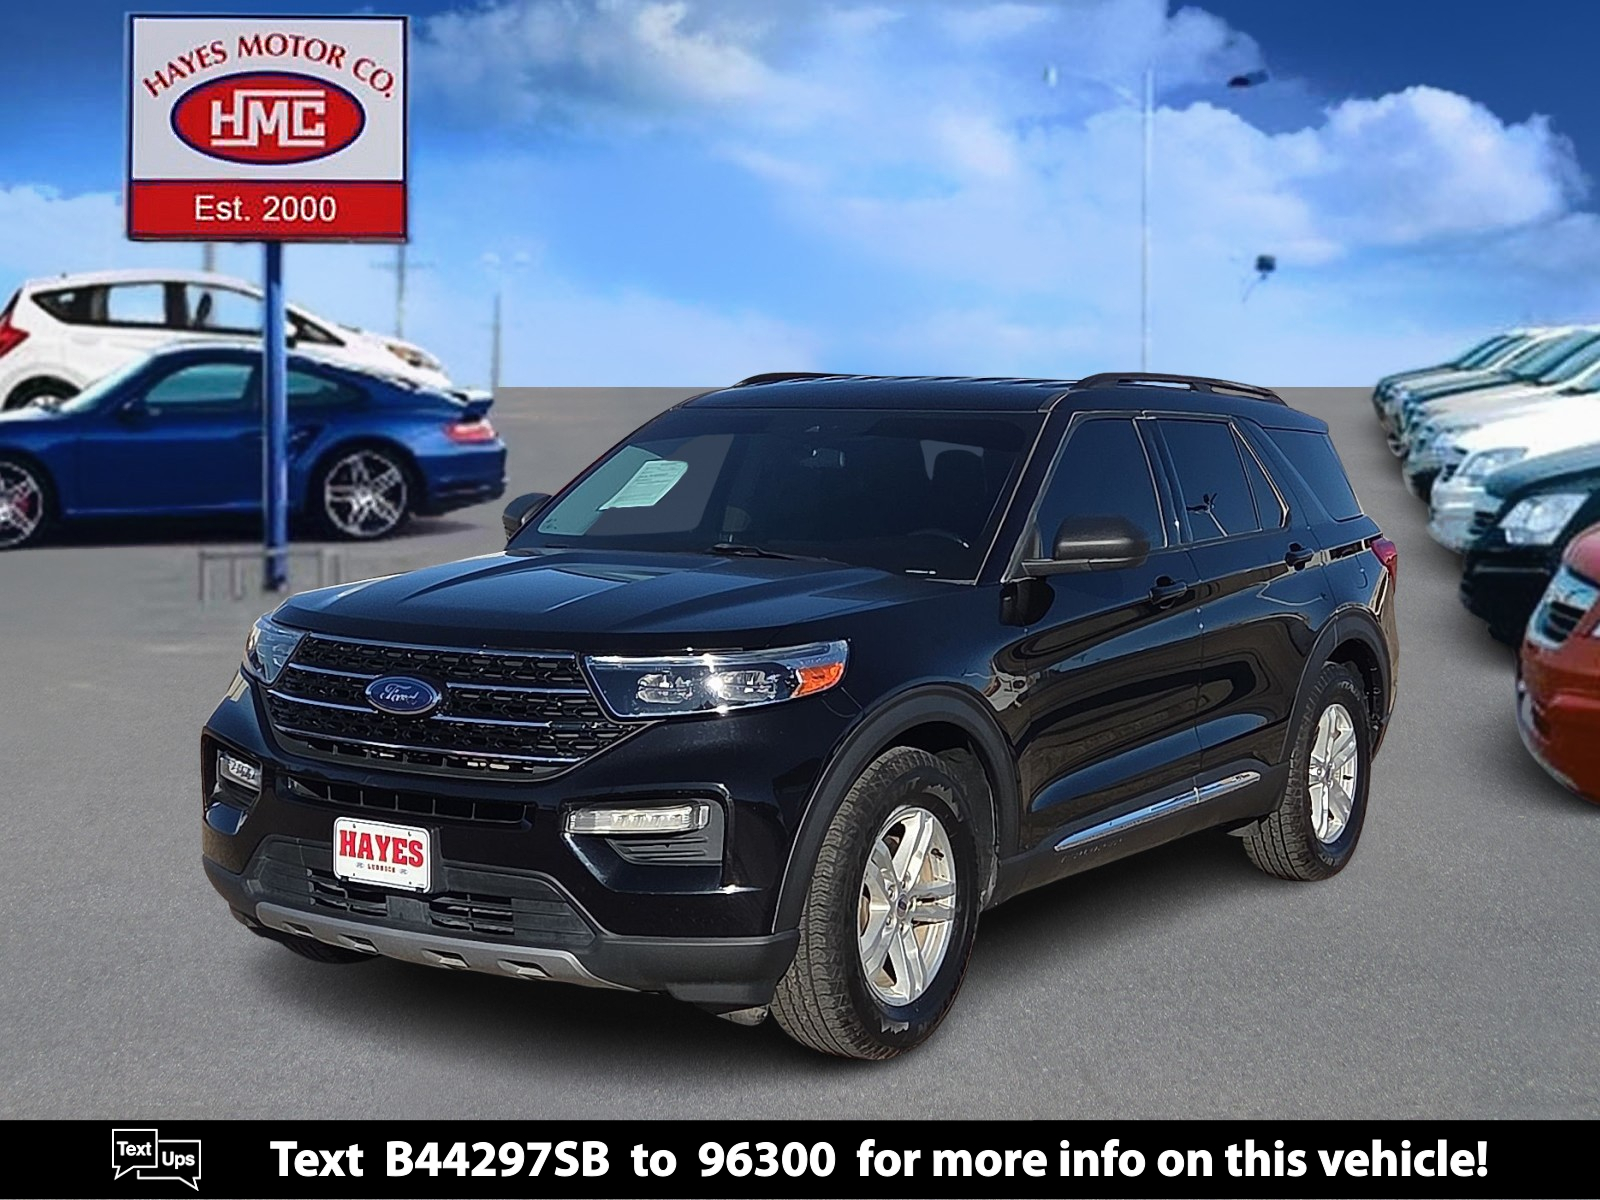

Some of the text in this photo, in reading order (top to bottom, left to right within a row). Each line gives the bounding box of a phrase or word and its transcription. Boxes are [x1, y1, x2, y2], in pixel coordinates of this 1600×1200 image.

[142, 32, 395, 99] HAYES MOTOR CO.
[210, 88, 326, 148] HMC
[194, 194, 338, 223] Est. 2000
[379, 682, 420, 706] Ford
[339, 829, 424, 868] HAYES
